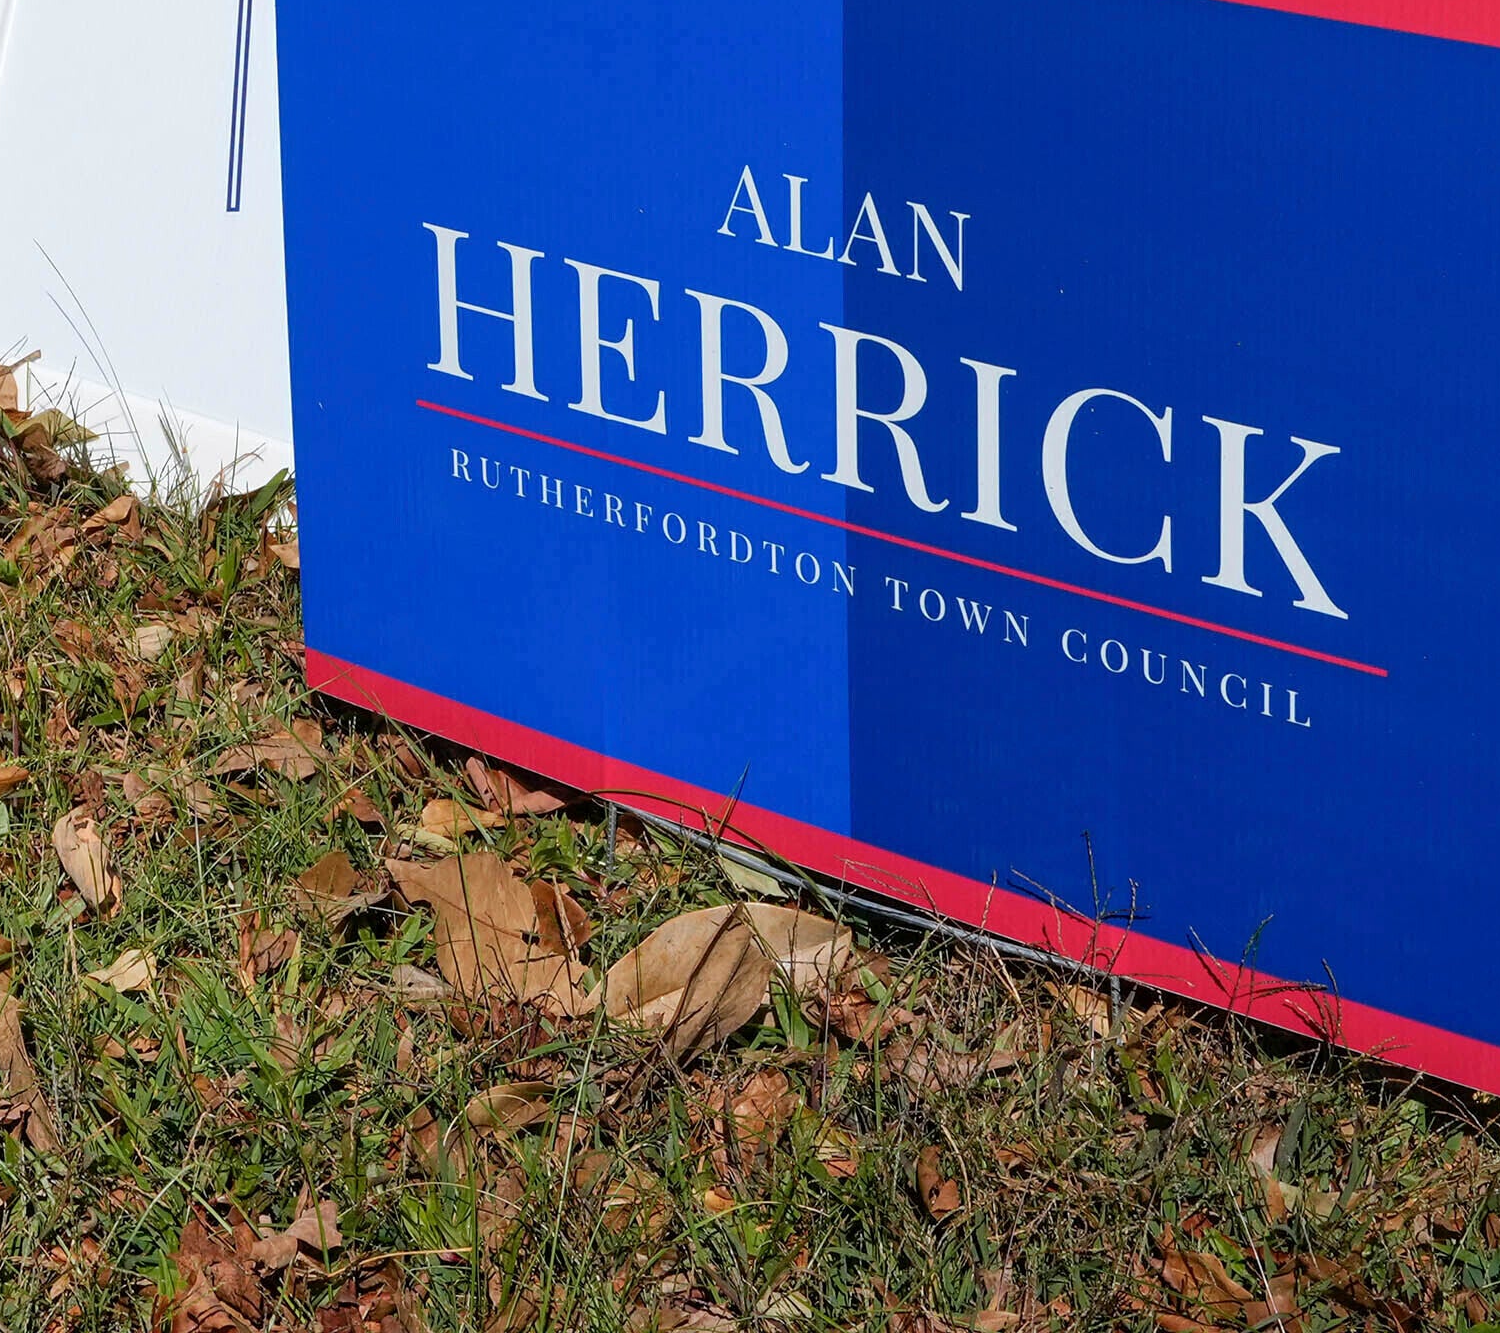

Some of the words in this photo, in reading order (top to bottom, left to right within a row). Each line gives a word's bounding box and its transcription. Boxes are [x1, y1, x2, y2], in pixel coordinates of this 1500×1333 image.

[716, 164, 970, 292] ALAN
[422, 222, 1348, 621] HERRICK
[452, 448, 858, 597] RUTHERFORDTON
[885, 575, 1031, 647] TOWN
[1061, 628, 1312, 728] COUNCIL
